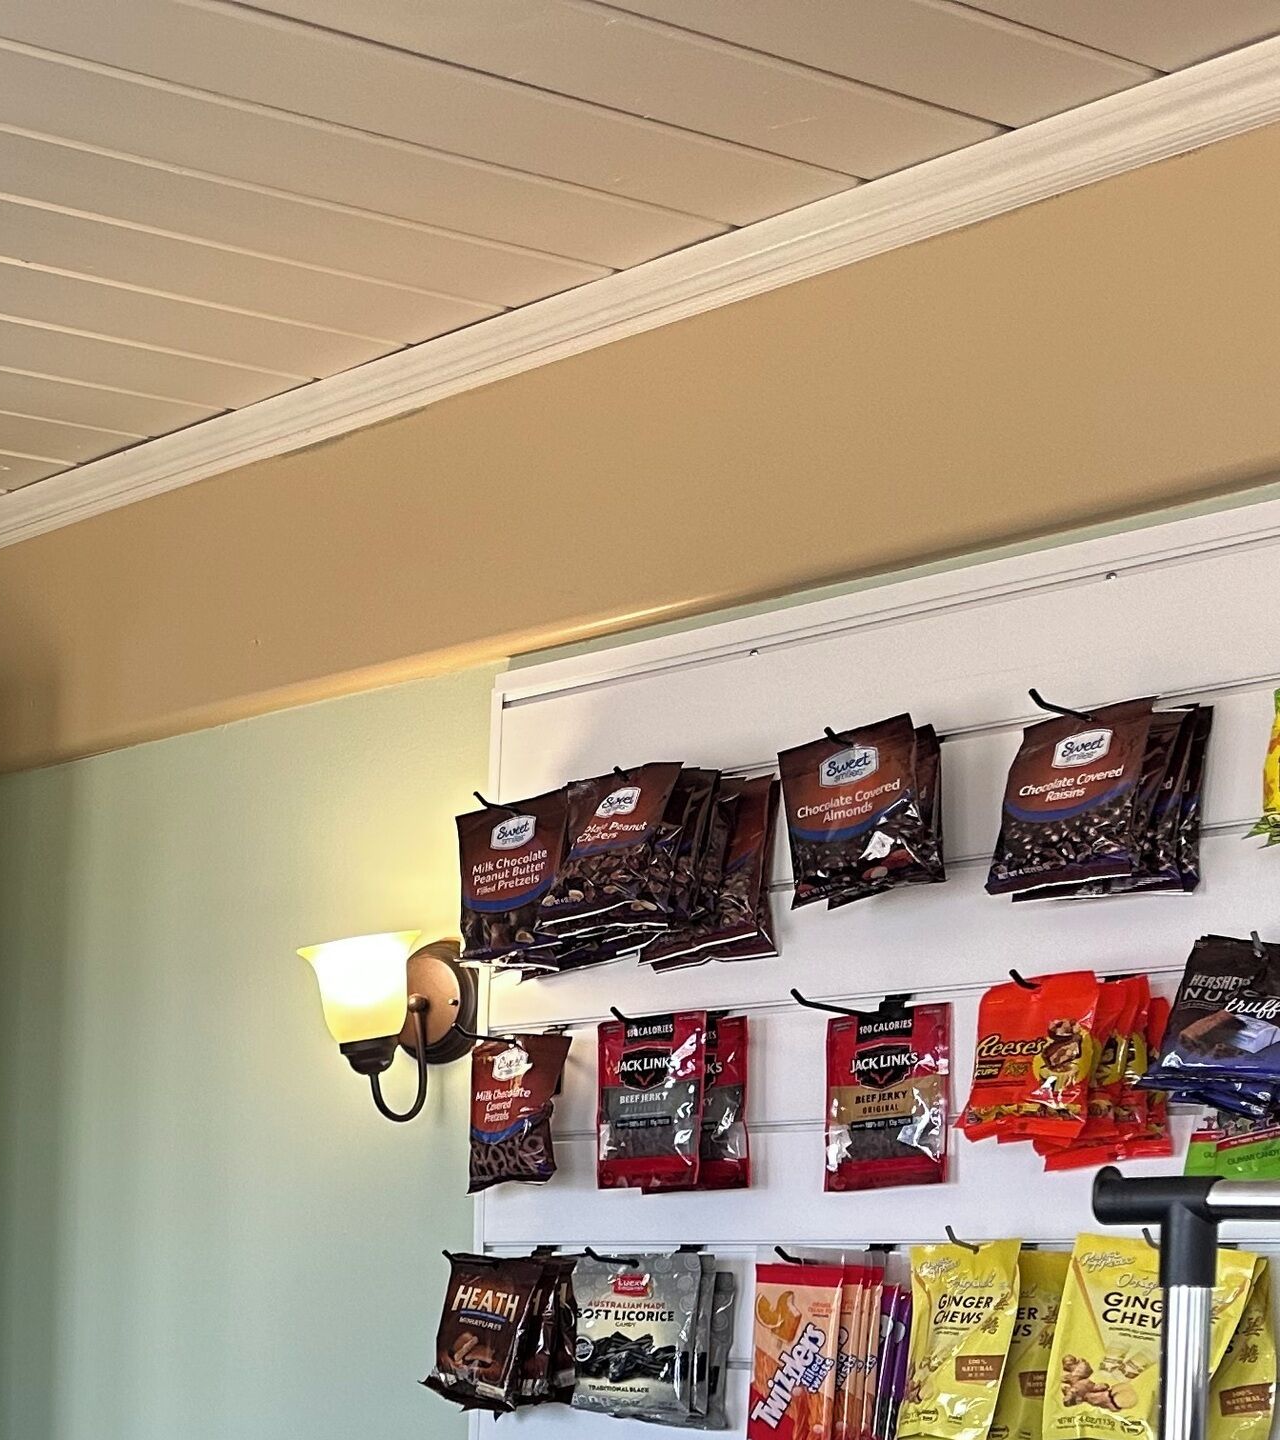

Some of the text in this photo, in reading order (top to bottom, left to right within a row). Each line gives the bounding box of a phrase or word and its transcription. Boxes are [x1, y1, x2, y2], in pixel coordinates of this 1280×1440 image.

[1062, 736, 1105, 758] Sweet
[826, 752, 871, 777] Sweet
[1019, 765, 1124, 797] Chocolate Covered
[797, 778, 901, 819] Chocolate Covered
[1045, 787, 1086, 803] Raisins
[823, 802, 873, 823] Almonds
[497, 820, 530, 840] Sweet
[609, 821, 648, 831] Peanut
[472, 849, 548, 876] Milk Chocolate
[473, 861, 546, 886] Peanut Butter
[497, 874, 540, 891] Pretzels
[639, 1024, 674, 1037] CALORIES
[859, 1019, 913, 1035] 100 CALORIES
[977, 1034, 1047, 1057] Reese's
[615, 1059, 642, 1075] JACK
[850, 1052, 919, 1073] JACK LINK'S
[619, 1091, 669, 1105] BEEF JERKY
[854, 1090, 908, 1105] BEEF JERKY
[862, 1105, 899, 1115] ORIGINAL
[452, 1285, 520, 1322] HEATH
[588, 1301, 666, 1310] AUSTRALIAN MADE
[938, 1294, 994, 1310] GINGER
[1104, 1291, 1163, 1313] GING
[576, 1308, 675, 1322] SOFT LICORICE
[933, 1310, 983, 1325] CHEWS
[800, 1352, 825, 1387] filled
[808, 1357, 835, 1394] twists
